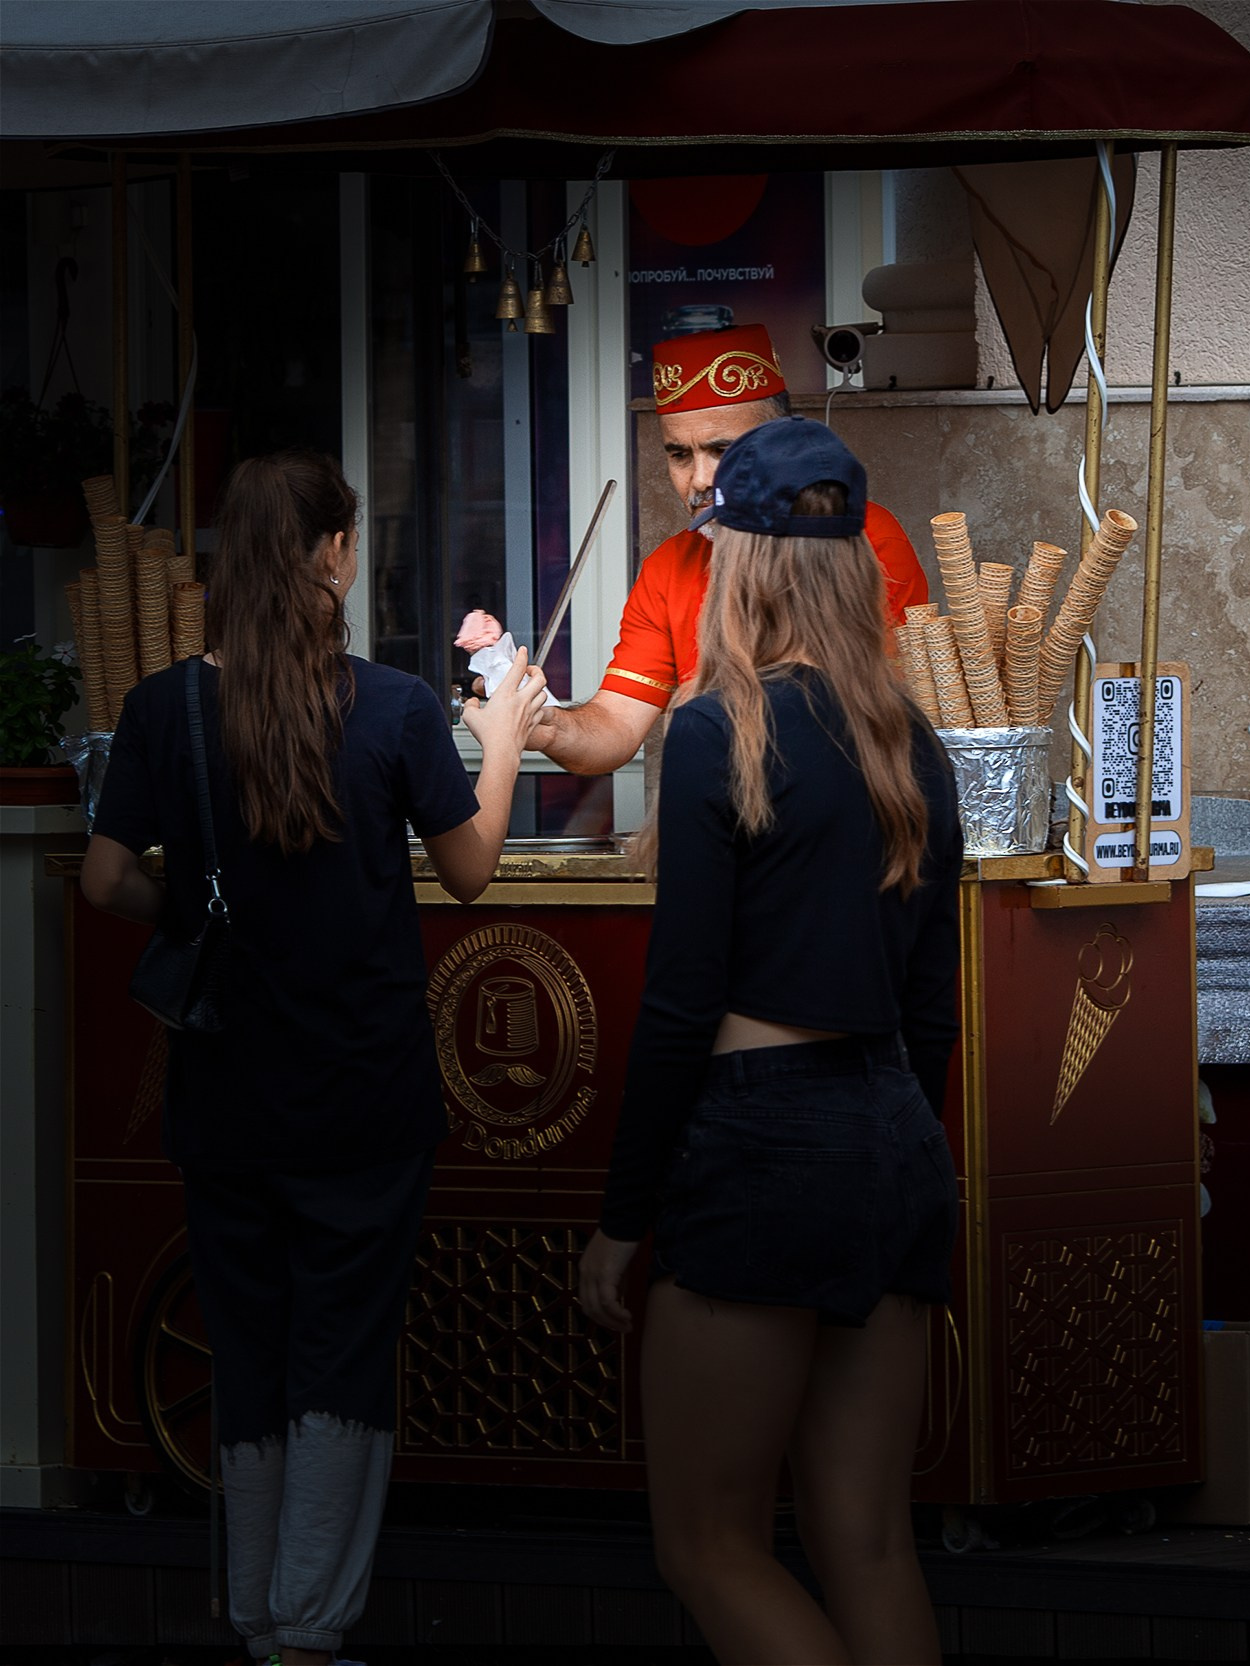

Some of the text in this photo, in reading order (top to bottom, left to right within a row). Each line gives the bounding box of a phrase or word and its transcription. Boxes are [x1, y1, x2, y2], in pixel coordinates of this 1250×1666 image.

[628, 264, 774, 284] ОПРОБУЙ... ПОЧУВСТВУЙ
[1096, 842, 1179, 858] WWW.BEYDURMA.RU
[461, 1085, 598, 1160] Dondurma
